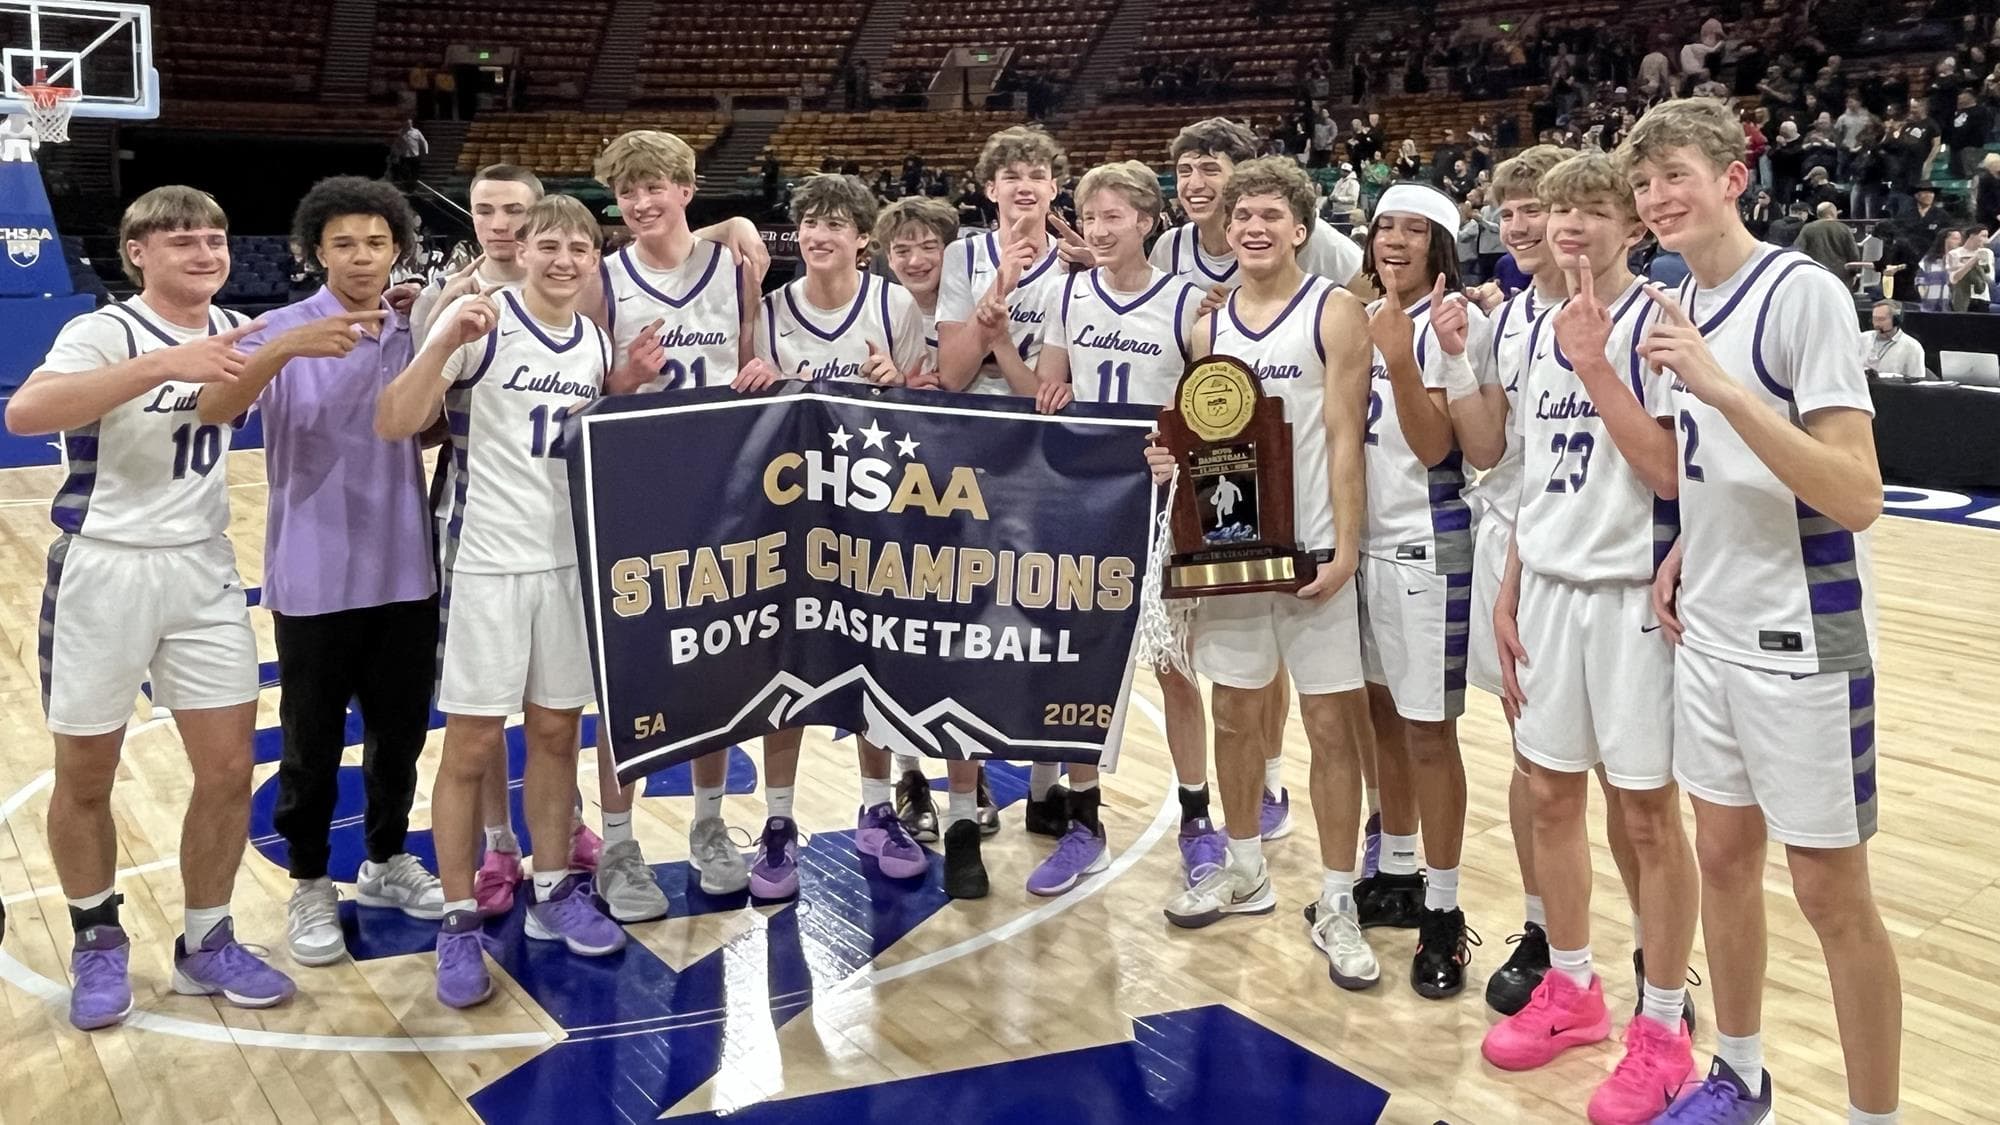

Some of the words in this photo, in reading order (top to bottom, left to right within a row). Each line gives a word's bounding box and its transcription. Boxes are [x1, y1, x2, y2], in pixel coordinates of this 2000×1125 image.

[1073, 324, 1162, 356] Lutheran
[502, 365, 598, 399] Lutheran
[660, 356, 706, 391] 21
[1097, 360, 1131, 403] 11
[172, 423, 222, 480] 10
[1545, 431, 1595, 493] 23
[763, 450, 989, 520] CHSAA
[610, 531, 788, 618] STATE
[806, 526, 1136, 612] CHAMPIONS
[670, 603, 781, 666] BOYS
[795, 597, 1080, 664] BASKETBALL
[633, 713, 667, 740] 5A
[1044, 703, 1112, 728] 2026
